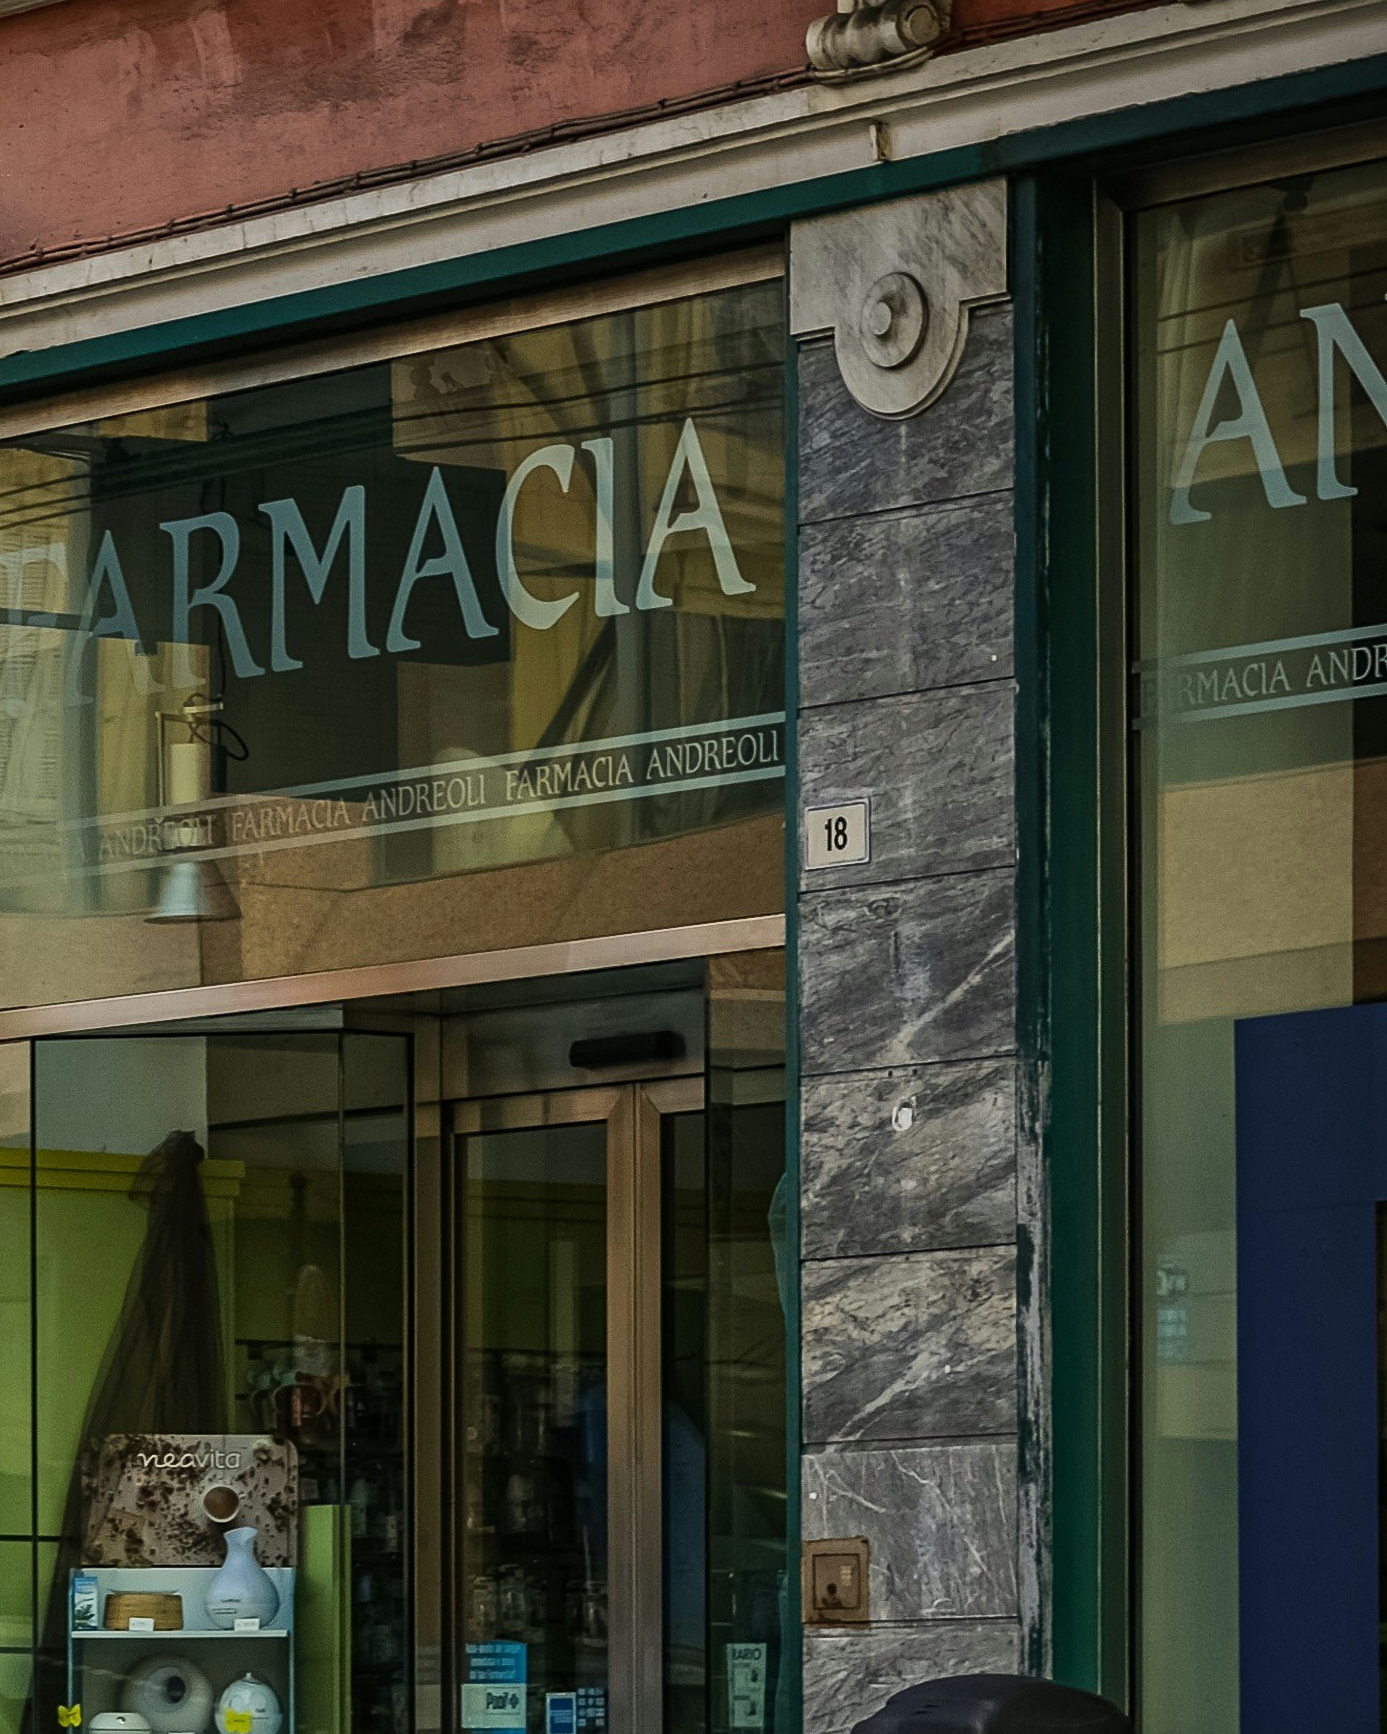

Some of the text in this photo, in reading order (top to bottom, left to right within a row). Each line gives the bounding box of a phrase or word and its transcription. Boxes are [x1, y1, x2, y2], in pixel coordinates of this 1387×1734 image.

[230, 798, 352, 842] FARMACIA
[361, 774, 486, 823] ANDREOLI
[504, 753, 634, 802] FARMACIA
[645, 729, 779, 780] ANDREOLI
[823, 816, 849, 851] 18
[137, 1448, 241, 1469] neavita
